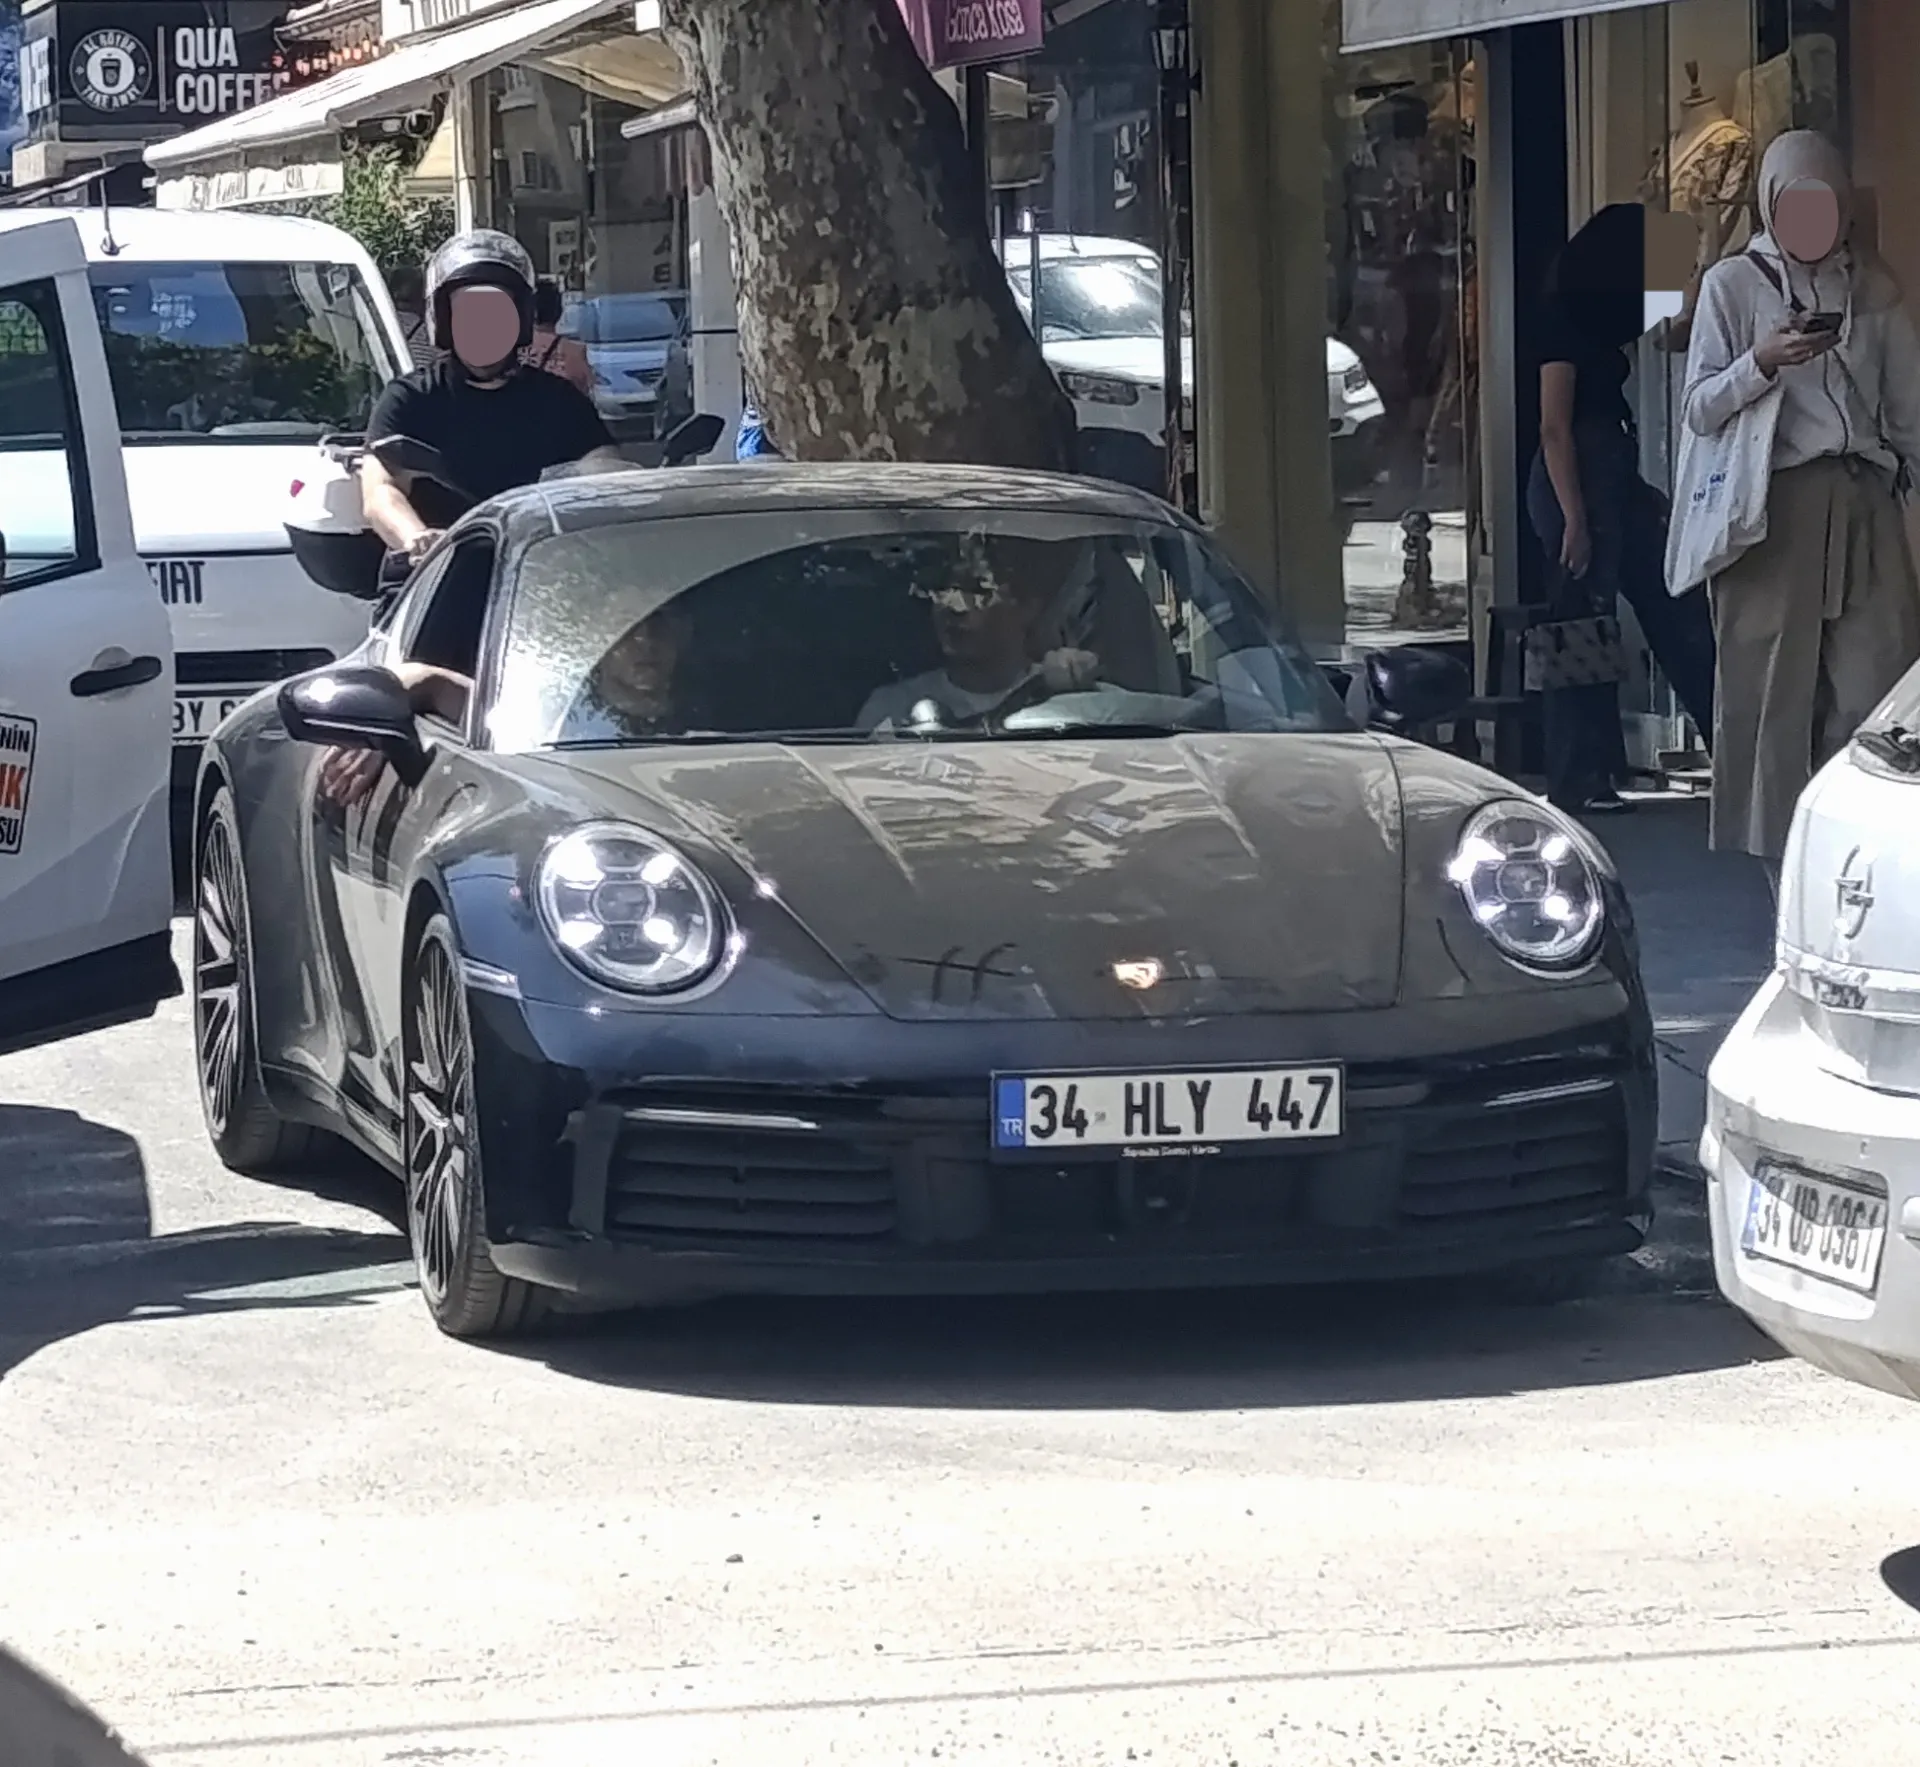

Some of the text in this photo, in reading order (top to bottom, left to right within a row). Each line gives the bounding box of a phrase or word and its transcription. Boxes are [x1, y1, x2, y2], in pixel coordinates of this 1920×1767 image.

[175, 27, 239, 69] QUA
[1002, 1117, 1023, 1137] TR
[1030, 1075, 1334, 1139] 34 HLY 447
